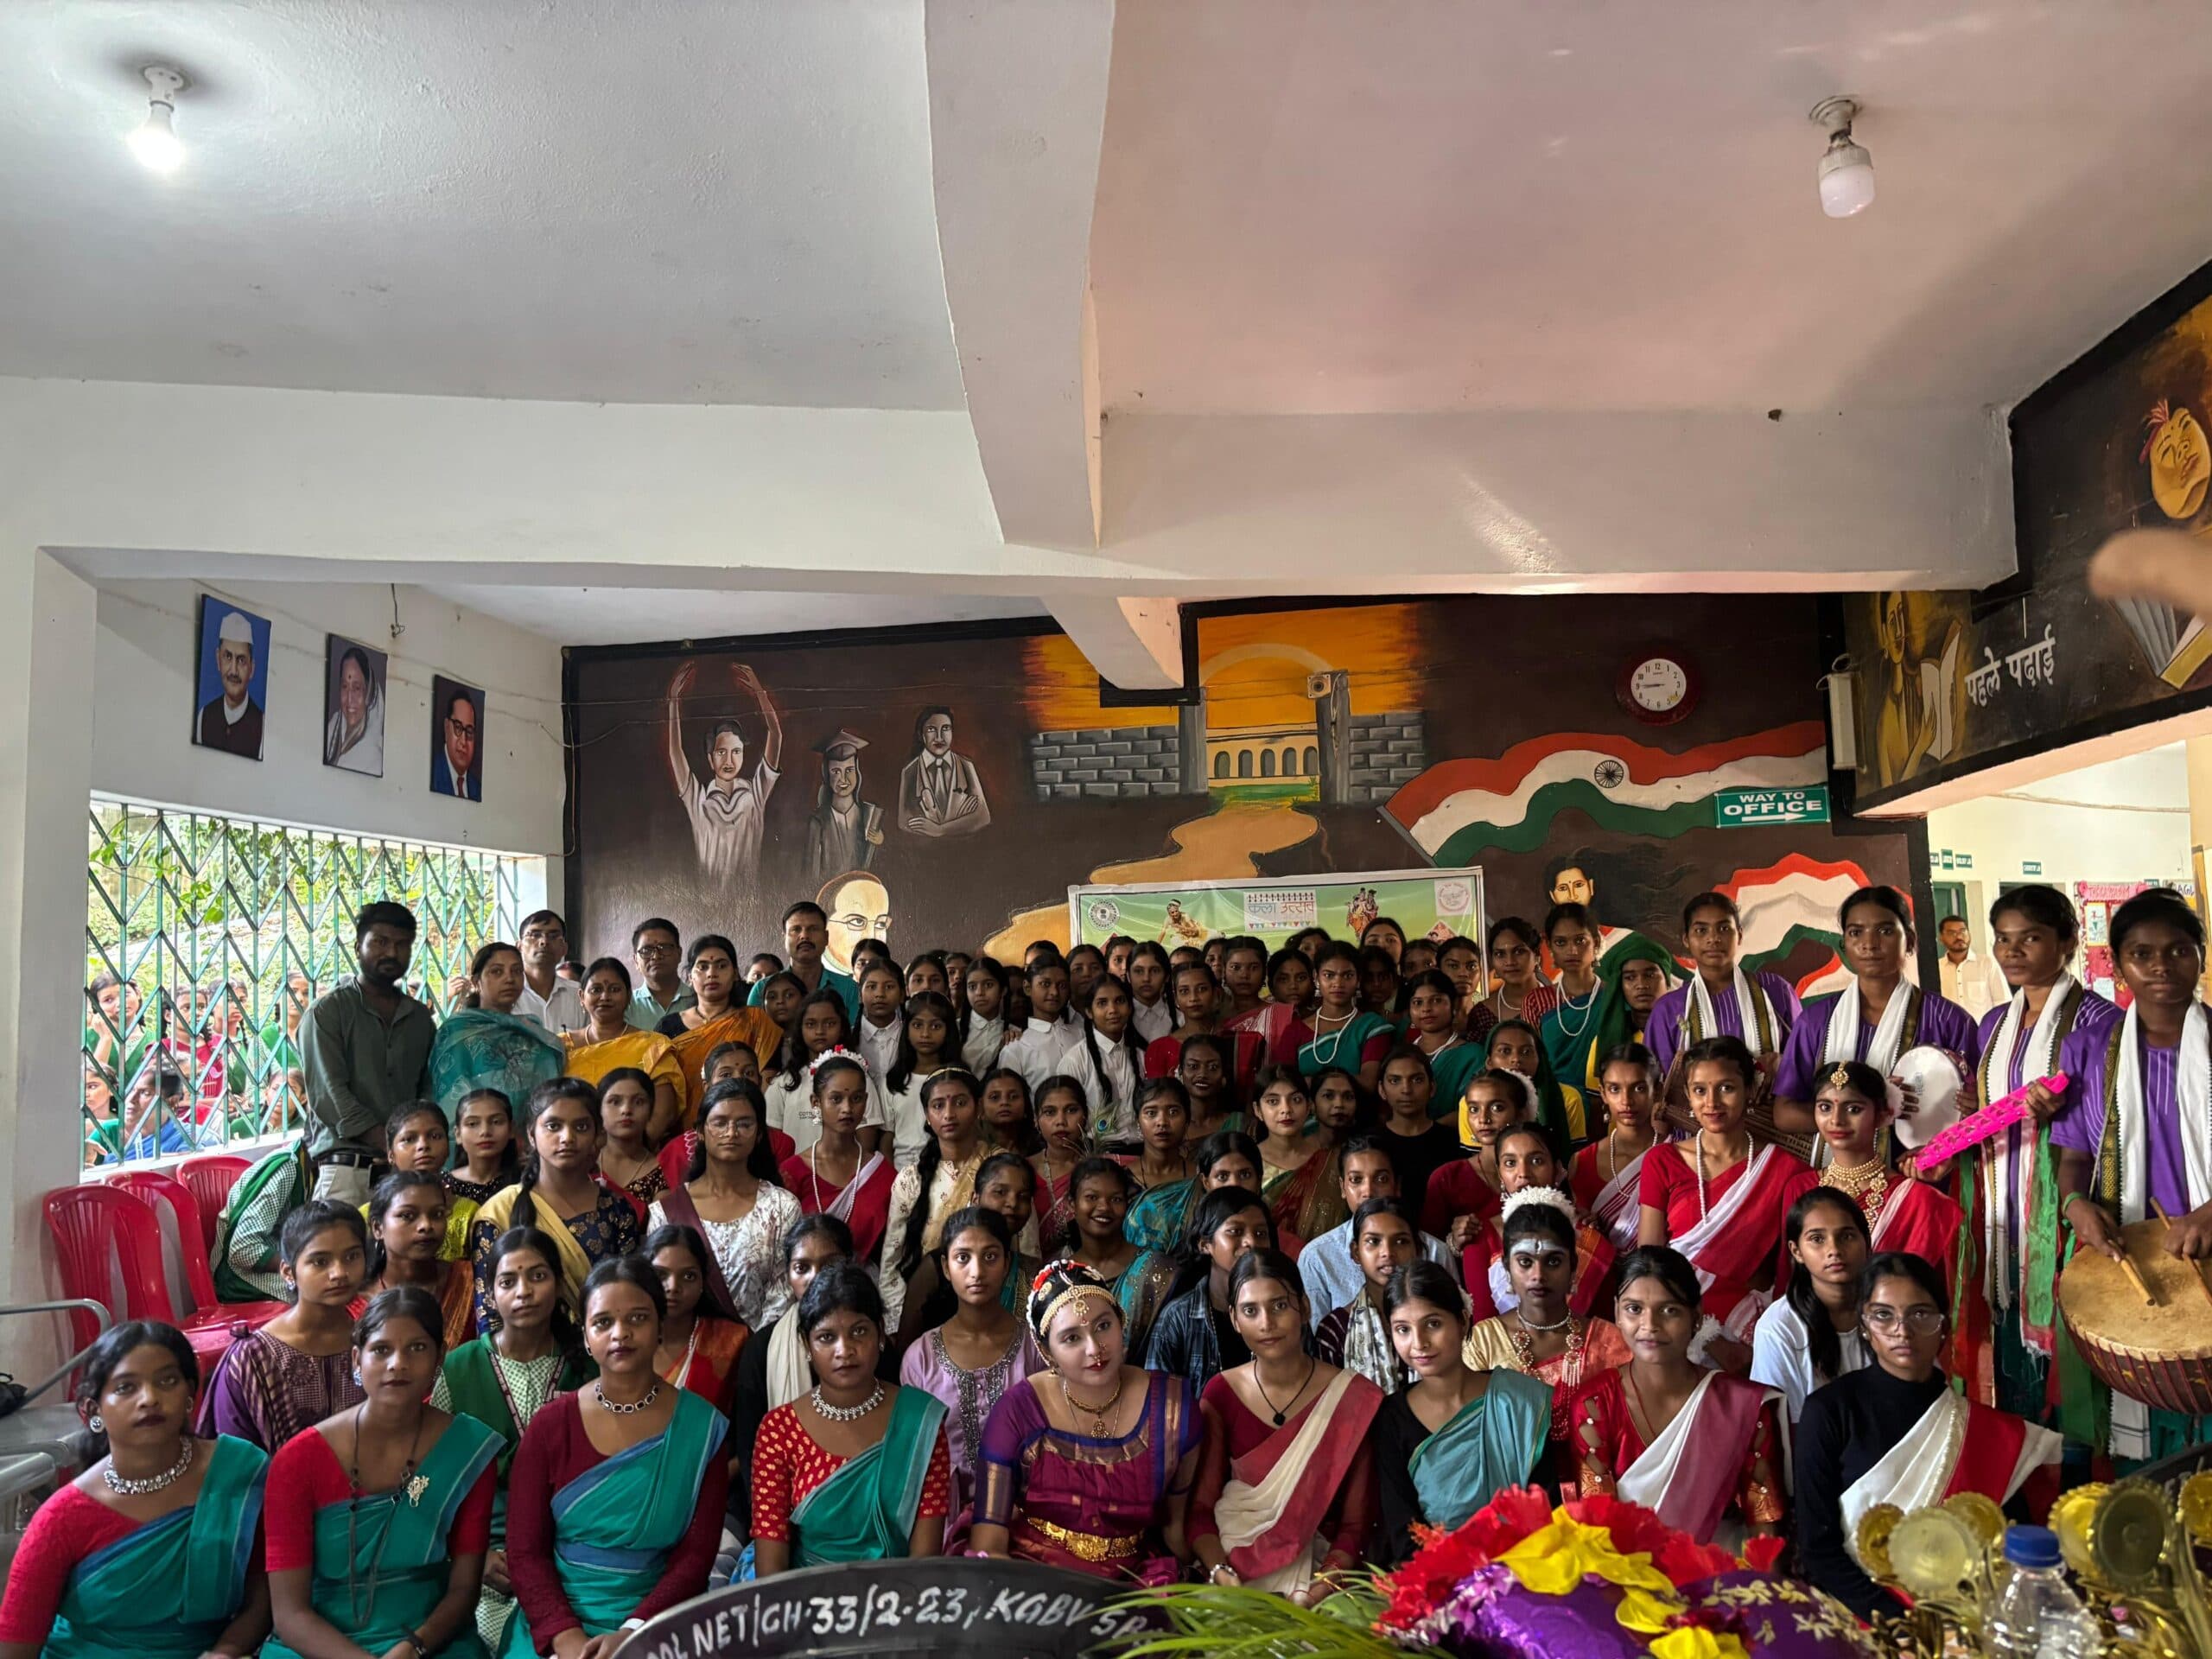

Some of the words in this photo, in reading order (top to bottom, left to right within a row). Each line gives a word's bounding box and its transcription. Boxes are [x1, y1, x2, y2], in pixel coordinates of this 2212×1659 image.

[1964, 646, 2002, 707] पहले
[1739, 793, 1777, 803] WAY
[1782, 791, 1805, 800] TO
[1723, 800, 1823, 816] OFFICE
